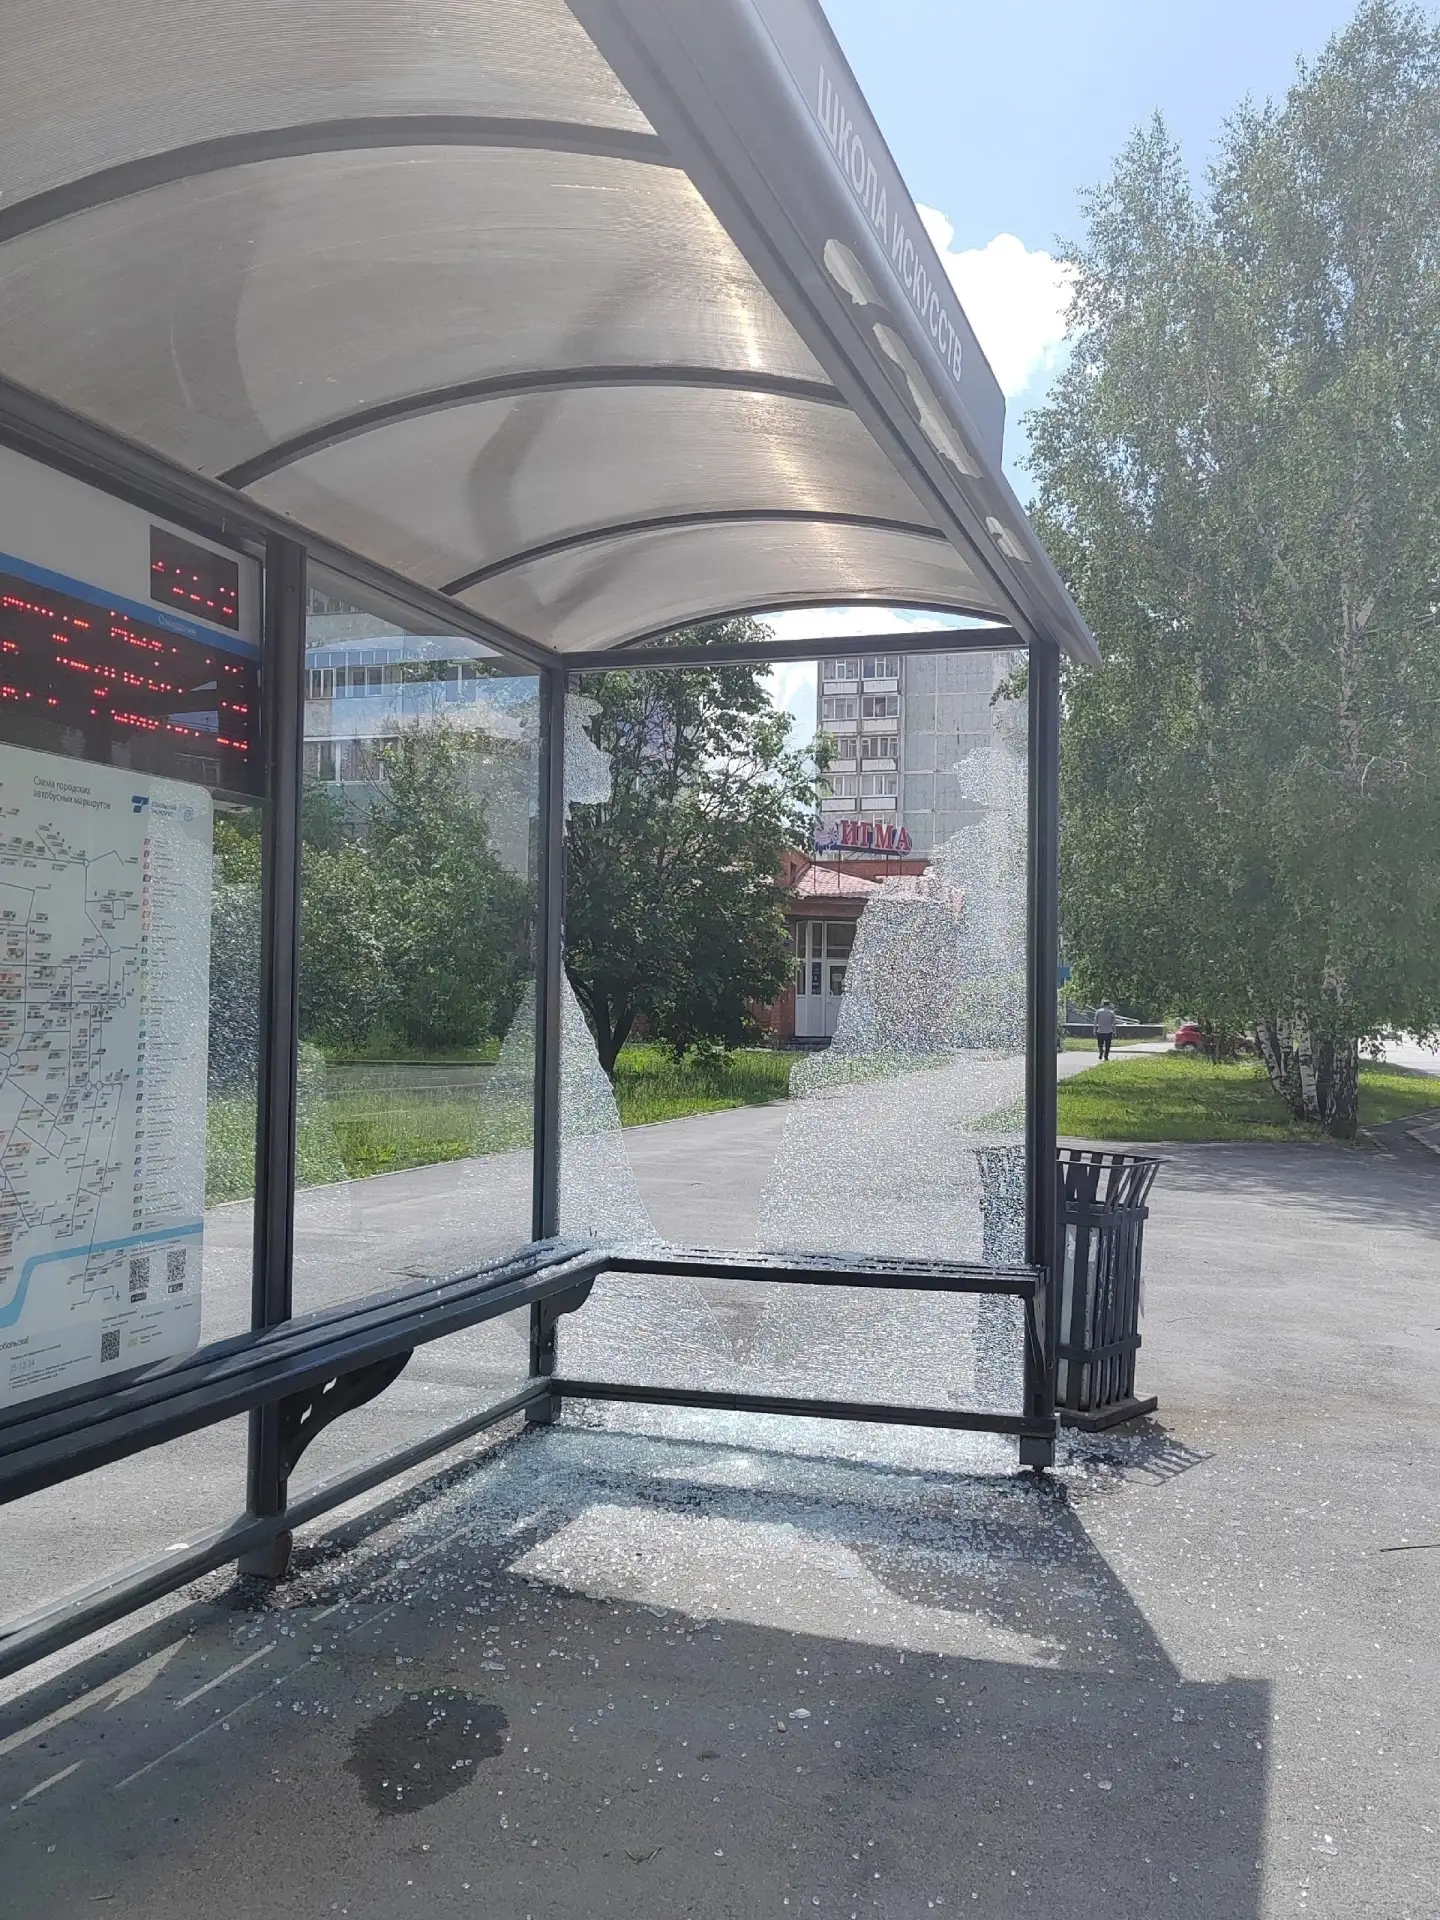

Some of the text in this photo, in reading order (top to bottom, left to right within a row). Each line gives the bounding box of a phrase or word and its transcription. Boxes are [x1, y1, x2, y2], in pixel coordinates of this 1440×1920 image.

[816, 64, 964, 383] ШКОЛА ИСКУССТВ
[32, 788, 111, 811] автобусных маршрутов
[33, 776, 92, 796] Схема городских
[840, 819, 912, 852] ИГМА
